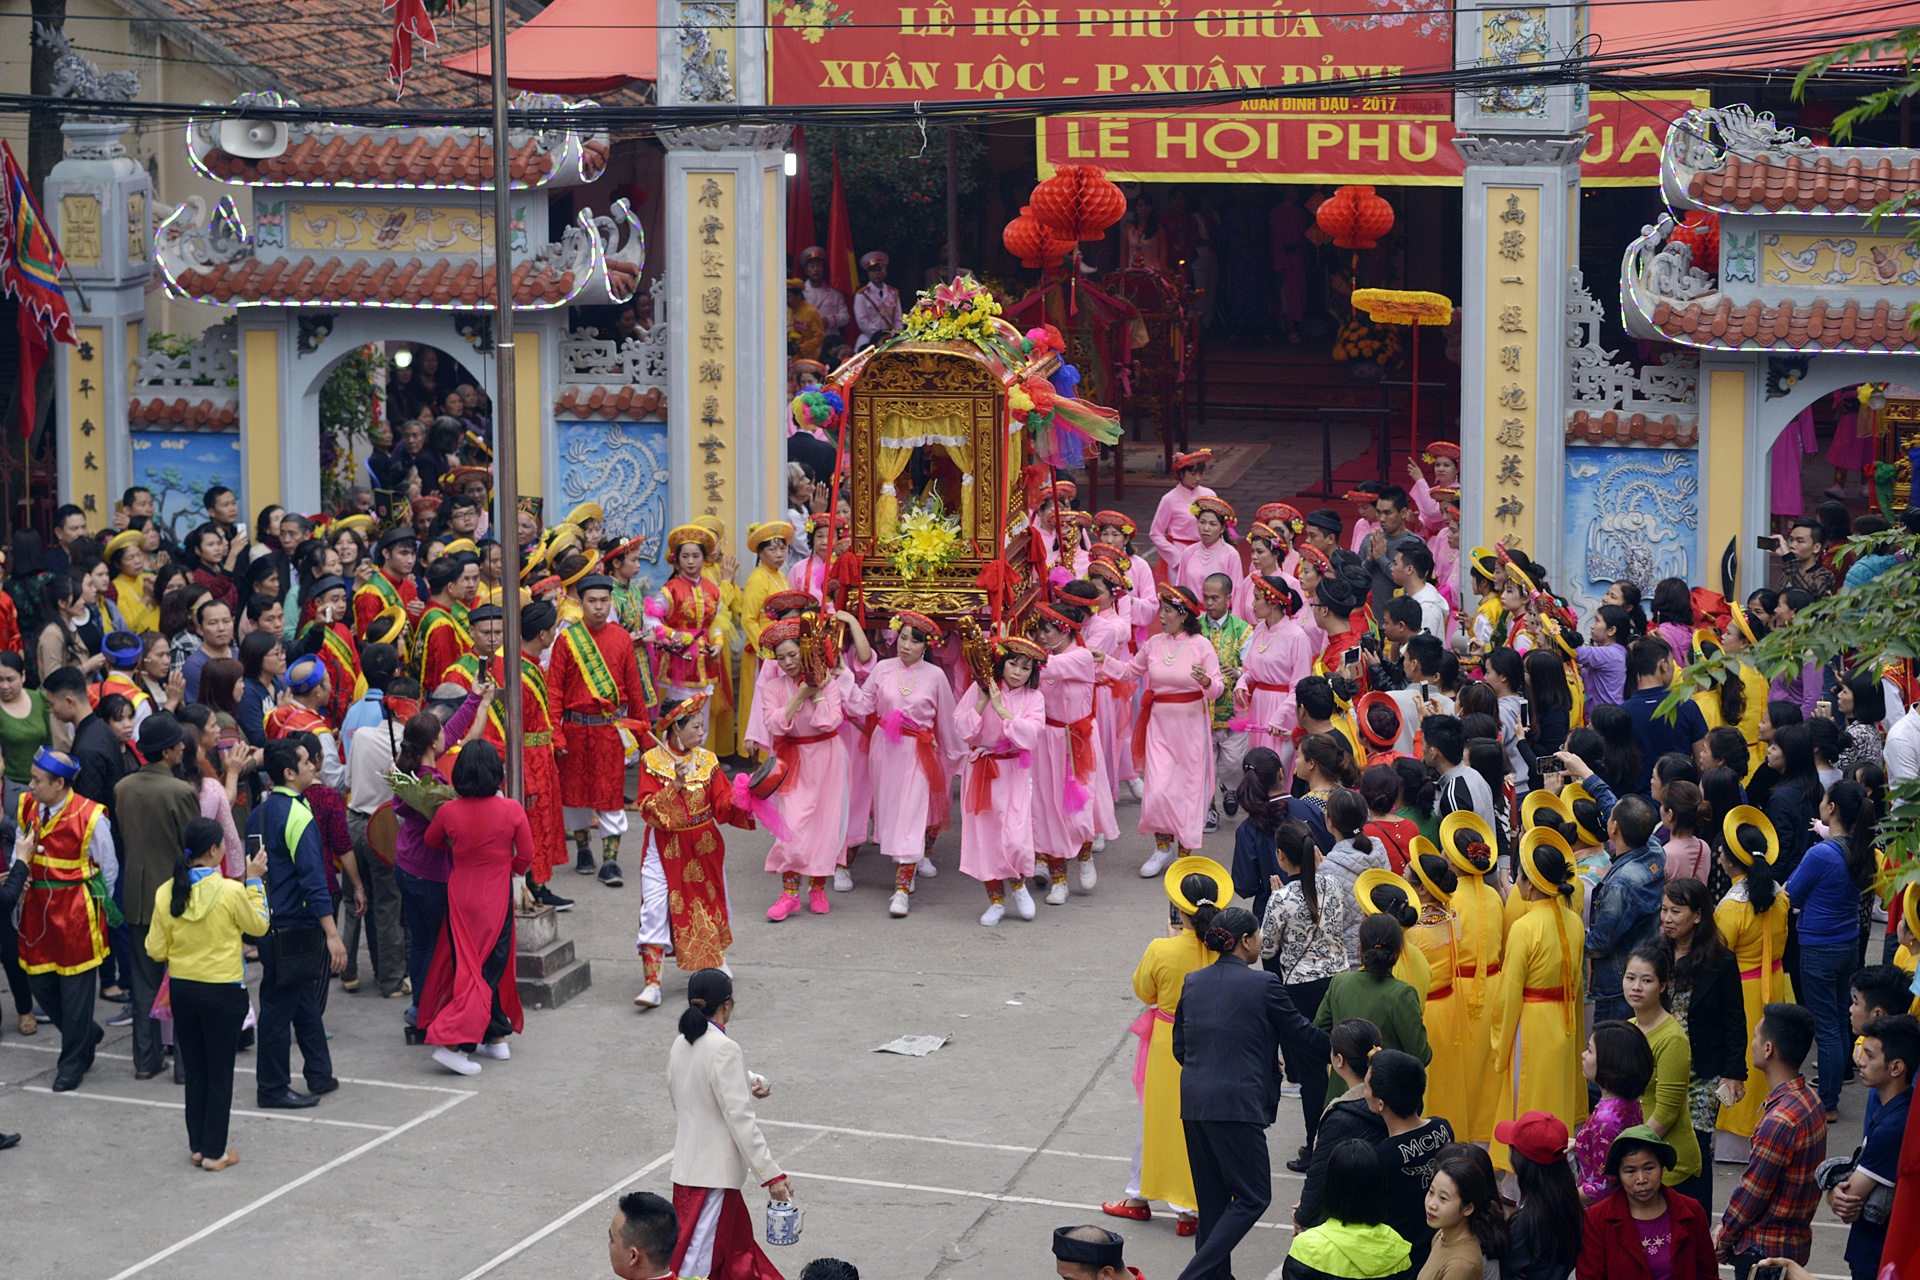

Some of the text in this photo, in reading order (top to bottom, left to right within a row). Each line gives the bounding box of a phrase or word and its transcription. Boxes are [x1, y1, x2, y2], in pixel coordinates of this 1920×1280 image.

[972, 0, 1061, 47] HỘI
[1076, 0, 1178, 38] PHỦ
[1193, 0, 1324, 38] CHÚA
[818, 52, 941, 90] XUÂN
[954, 54, 1045, 100] LỘC
[1095, 55, 1267, 92] P.XUÂN
[1362, 98, 1397, 111] 2017
[1398, 1124, 1451, 1164] MCM
